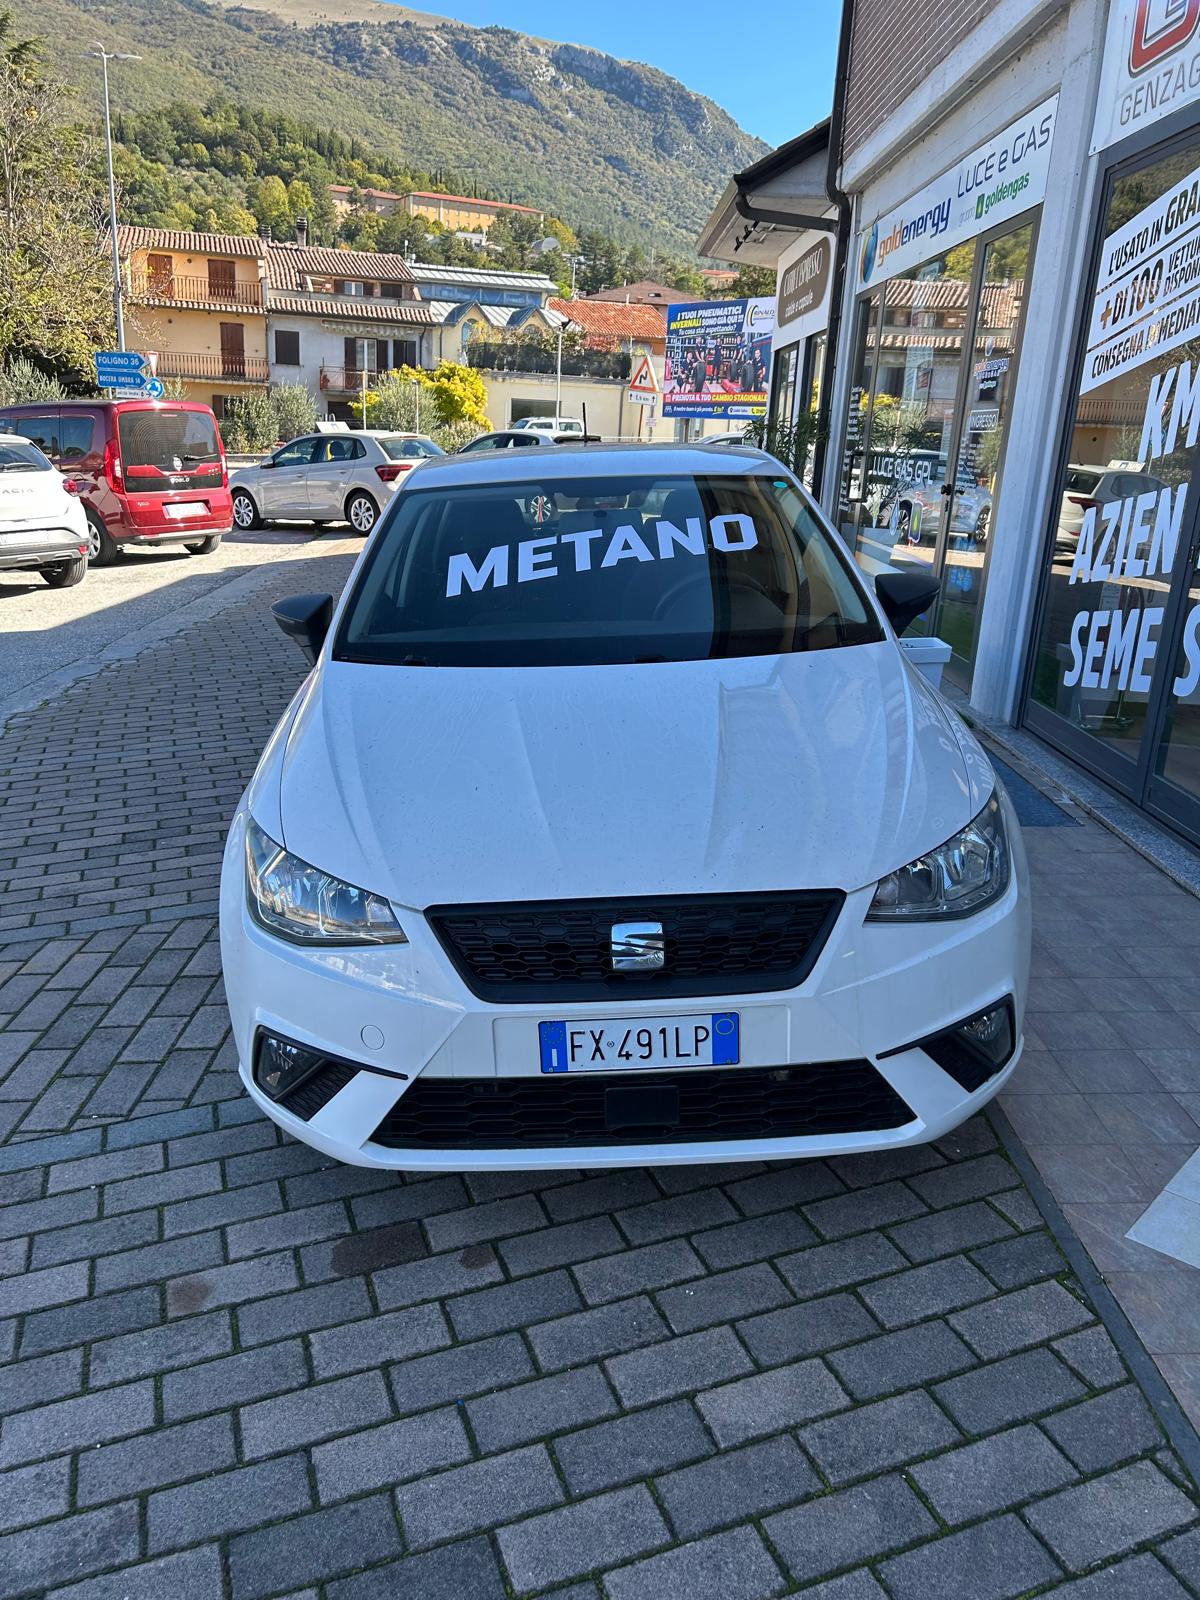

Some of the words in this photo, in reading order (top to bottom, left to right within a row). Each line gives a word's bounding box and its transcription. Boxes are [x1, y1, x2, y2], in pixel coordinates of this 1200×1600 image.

[957, 151, 996, 198] LUCE
[998, 149, 1009, 173] e
[1011, 114, 1053, 165] GAS
[984, 172, 1030, 215] goldengas
[877, 197, 952, 268] goldenergy
[1108, 226, 1149, 277] L'USATO
[1149, 215, 1164, 248] IN
[1128, 258, 1164, 317] 100
[670, 318, 702, 330] INVERNALI
[702, 316, 717, 326] SONO
[681, 310, 697, 320] TUOI
[697, 305, 742, 318] PNEUMATICI
[97, 356, 129, 365] FOLIGNO
[1091, 329, 1145, 379] CONSEGNA
[700, 394, 712, 402] TUO
[711, 394, 734, 402] CAMBIO
[733, 394, 768, 403] STAGIONALE
[873, 456, 894, 478] LUCE
[446, 514, 759, 598] METANO
